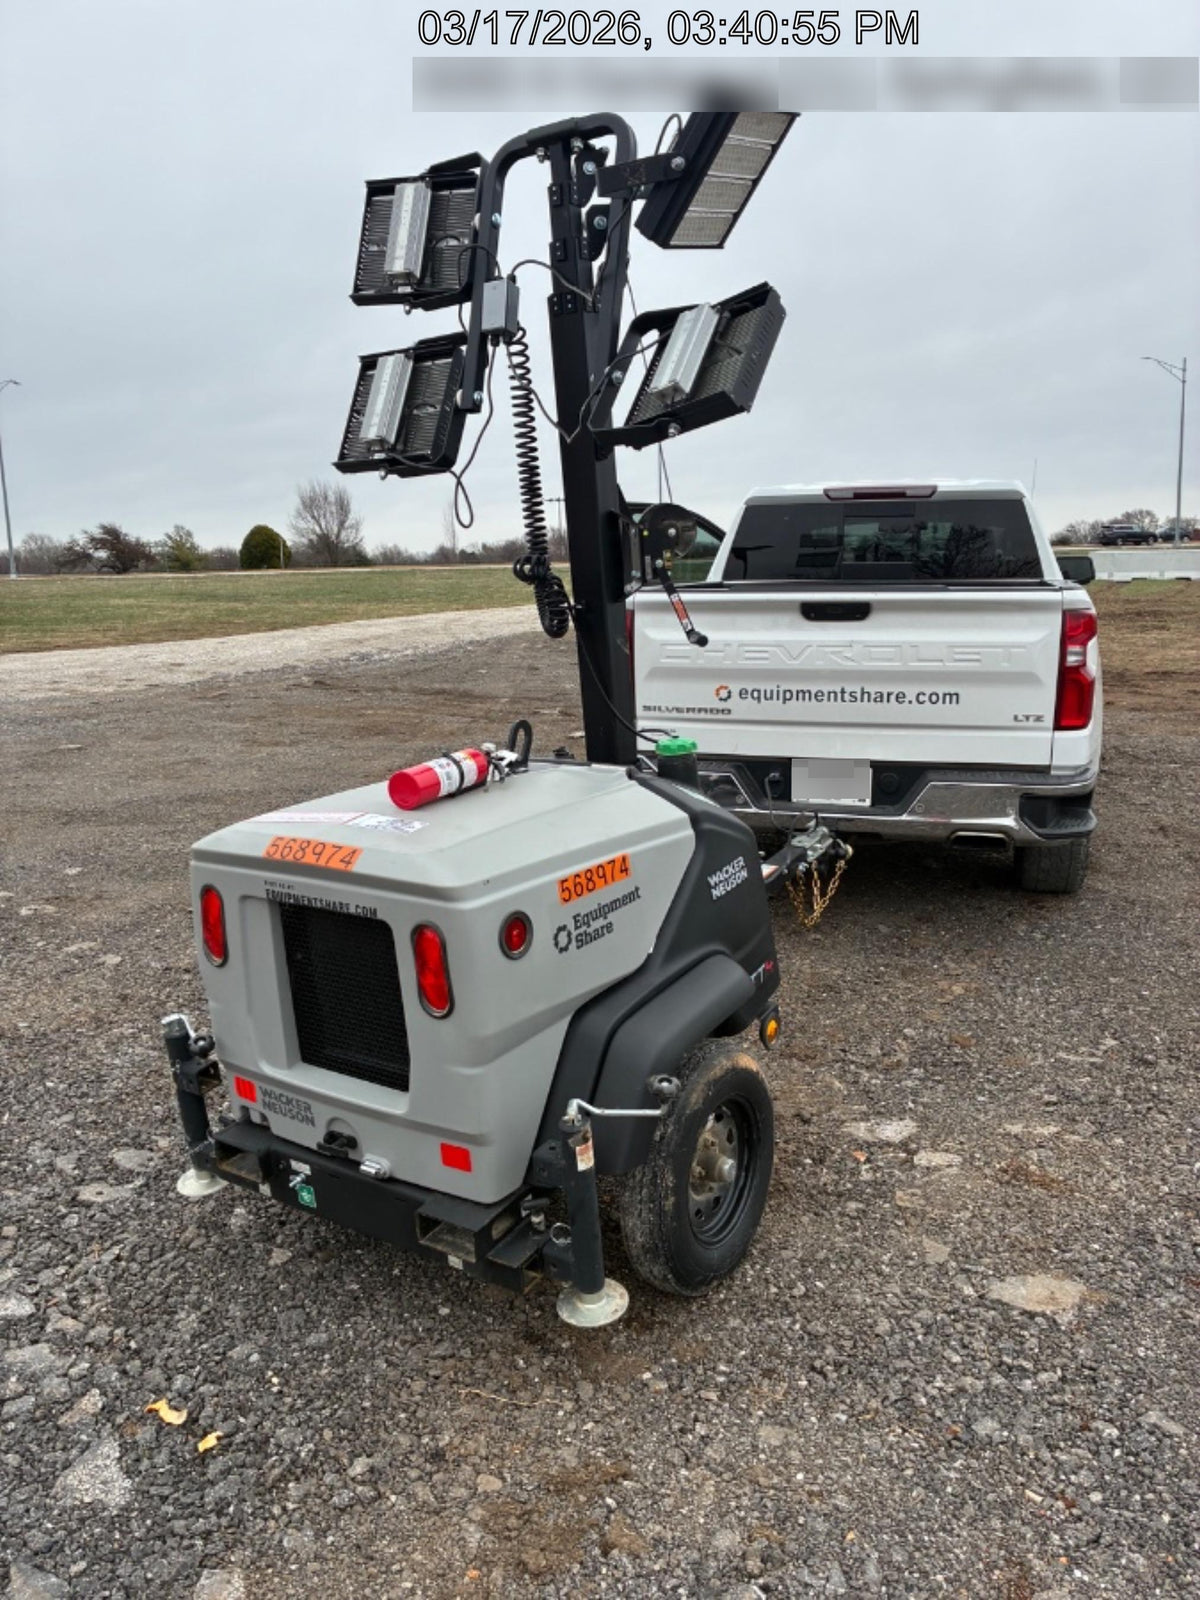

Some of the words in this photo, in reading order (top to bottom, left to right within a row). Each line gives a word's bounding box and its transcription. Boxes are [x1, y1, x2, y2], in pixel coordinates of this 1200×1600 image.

[659, 642, 1028, 667] CHEVROLET
[641, 704, 732, 716] SILVERADO
[738, 684, 961, 706] equipmentshare.com
[1013, 713, 1045, 723] LTZ
[265, 837, 358, 870] 568974
[560, 855, 629, 903] 568974
[707, 856, 746, 887] WACKER
[711, 867, 748, 900] NEUSON
[572, 884, 641, 931] Equipment
[574, 921, 615, 950] Share
[259, 1085, 313, 1116] WACKER
[262, 1099, 317, 1128] NEUSON
